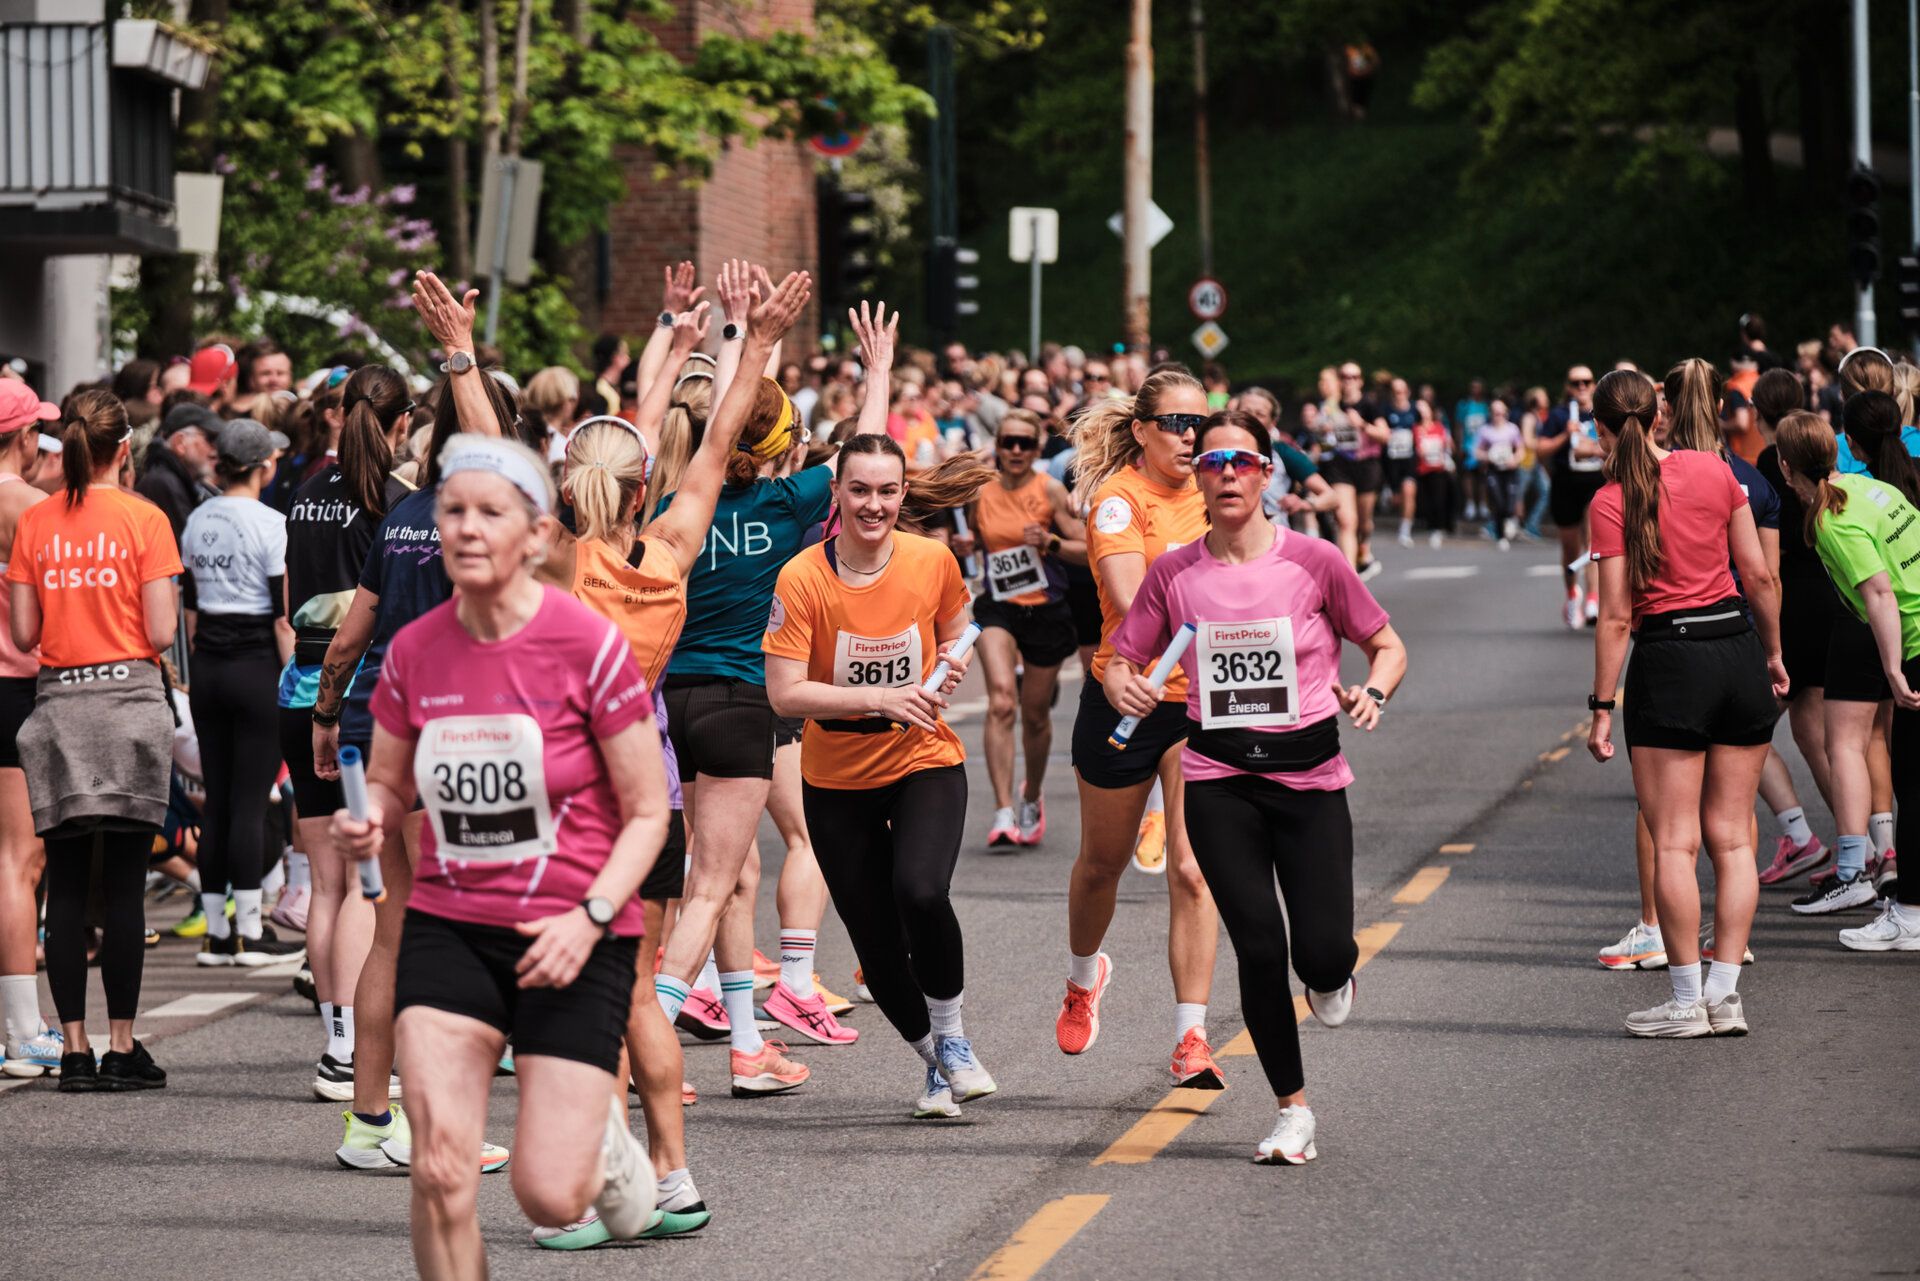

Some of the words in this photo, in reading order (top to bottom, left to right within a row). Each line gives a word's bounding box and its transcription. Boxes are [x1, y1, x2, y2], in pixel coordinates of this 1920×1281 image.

[290, 498, 360, 528] intility
[400, 526, 428, 541] there
[430, 526, 442, 541] b
[697, 512, 773, 571] NB
[992, 549, 1032, 575] 3614
[44, 567, 118, 590] CISCO
[1215, 629, 1271, 641] FirstPrice
[855, 639, 907, 652] FirstPrice
[59, 664, 130, 685] CISCO
[847, 656, 911, 685] 3613
[1211, 650, 1284, 684] 3632
[1228, 691, 1237, 703] Å
[1228, 703, 1271, 715] ENERGI
[441, 728, 513, 743] FirstPrice
[433, 761, 527, 805] 3608
[460, 830, 515, 845] ENERGI
[1824, 883, 1851, 902] HOKA
[1669, 1009, 1697, 1021] HOKA
[333, 1019, 345, 1038] NIKE
